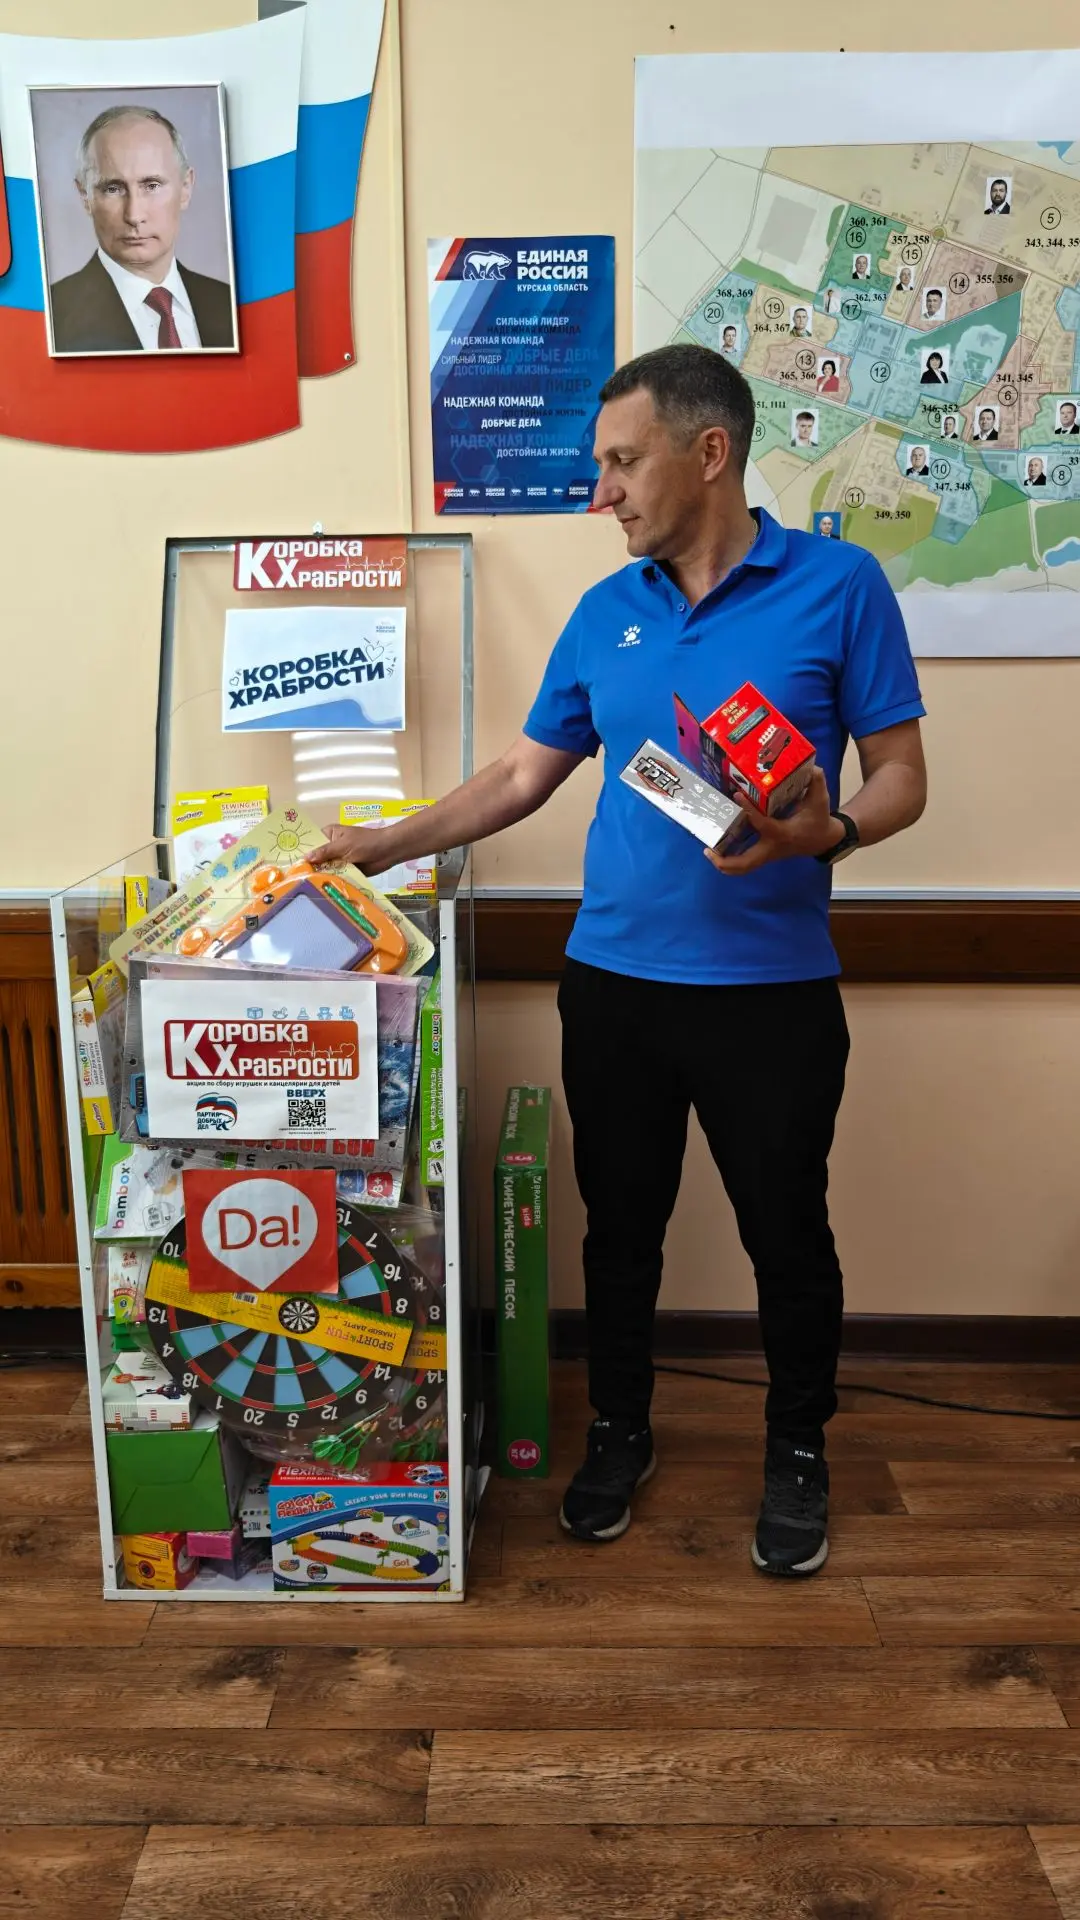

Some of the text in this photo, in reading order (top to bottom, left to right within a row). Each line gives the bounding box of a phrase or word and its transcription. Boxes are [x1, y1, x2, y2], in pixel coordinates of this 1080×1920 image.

[850, 217, 869, 226] 360,
[871, 216, 886, 226] 361
[1046, 212, 1054, 224] 5
[850, 232, 862, 243] 16
[914, 235, 930, 244] 358
[1025, 238, 1066, 248] 343, 344,
[517, 250, 588, 264] ЕДИНАЯ
[906, 249, 918, 260] 15
[517, 266, 588, 280] РОССИЯ
[976, 274, 1014, 284] 355, 356
[553, 284, 588, 292] ОБЛАСТЬ
[953, 278, 965, 289] 14
[716, 288, 753, 298] 368, 369
[873, 293, 887, 301] 363
[706, 308, 721, 319] 20
[768, 303, 780, 314] 19
[846, 304, 858, 316] 17
[496, 316, 570, 327] СИЛЬНЫЙ ЛИДЕР
[753, 323, 790, 334] 364, 367
[450, 336, 544, 346] НАДЕЖНАЯ КОМАНДА
[441, 354, 502, 364] СИЛЬНЫЙ ЛИДЕР
[800, 355, 812, 366] 13
[779, 371, 816, 381] 365, 366
[874, 366, 887, 378] 12
[1017, 374, 1033, 382] 345
[1004, 390, 1012, 401] 6
[444, 396, 544, 408] НАДЕЖНАЯ КОМАНДА
[942, 404, 959, 412] 352
[934, 412, 941, 423] 9
[481, 418, 542, 430] ДОБРЫЕ ДЕЛА
[496, 448, 580, 458] ДОСТОЙНАЯ ЖИЗНЬ
[934, 464, 947, 475] 10
[1058, 470, 1065, 481] 8
[934, 482, 970, 491] 347, 348
[850, 492, 860, 503] 11
[874, 510, 911, 520] 349, 350
[243, 646, 368, 687] КОРОБКА
[228, 662, 386, 710] ХРАБРОСТИ
[721, 700, 739, 718] PLAY
[728, 706, 750, 725] GAME
[634, 757, 684, 798] ТРЕК
[432, 1014, 442, 1053] bambox
[286, 1089, 326, 1098] ВВЕРХ
[370, 1178, 384, 1198] 8+
[112, 1169, 130, 1229] bambox
[336, 1208, 352, 1225] 19
[522, 1207, 530, 1227] kids
[218, 1205, 300, 1250] Da!
[366, 1232, 378, 1248] 7
[162, 1242, 180, 1258] 10
[504, 1176, 516, 1320] КИНЕТИЧЕСКИЙ ПЕСОК
[384, 1263, 402, 1282] 16
[396, 1298, 408, 1314] 8
[148, 1307, 168, 1324] 13
[428, 1305, 440, 1320] 8
[162, 1342, 174, 1358] 4
[374, 1364, 392, 1380] 14
[426, 1370, 444, 1384] 14
[182, 1372, 200, 1389] 18
[356, 1389, 368, 1404] 9
[216, 1396, 224, 1410] 1
[416, 1396, 428, 1410] 9
[244, 1408, 266, 1426] 20
[321, 1404, 338, 1420] 12
[286, 1412, 300, 1428] 5
[520, 1448, 537, 1460] 3
[393, 1558, 410, 1567] Go!
